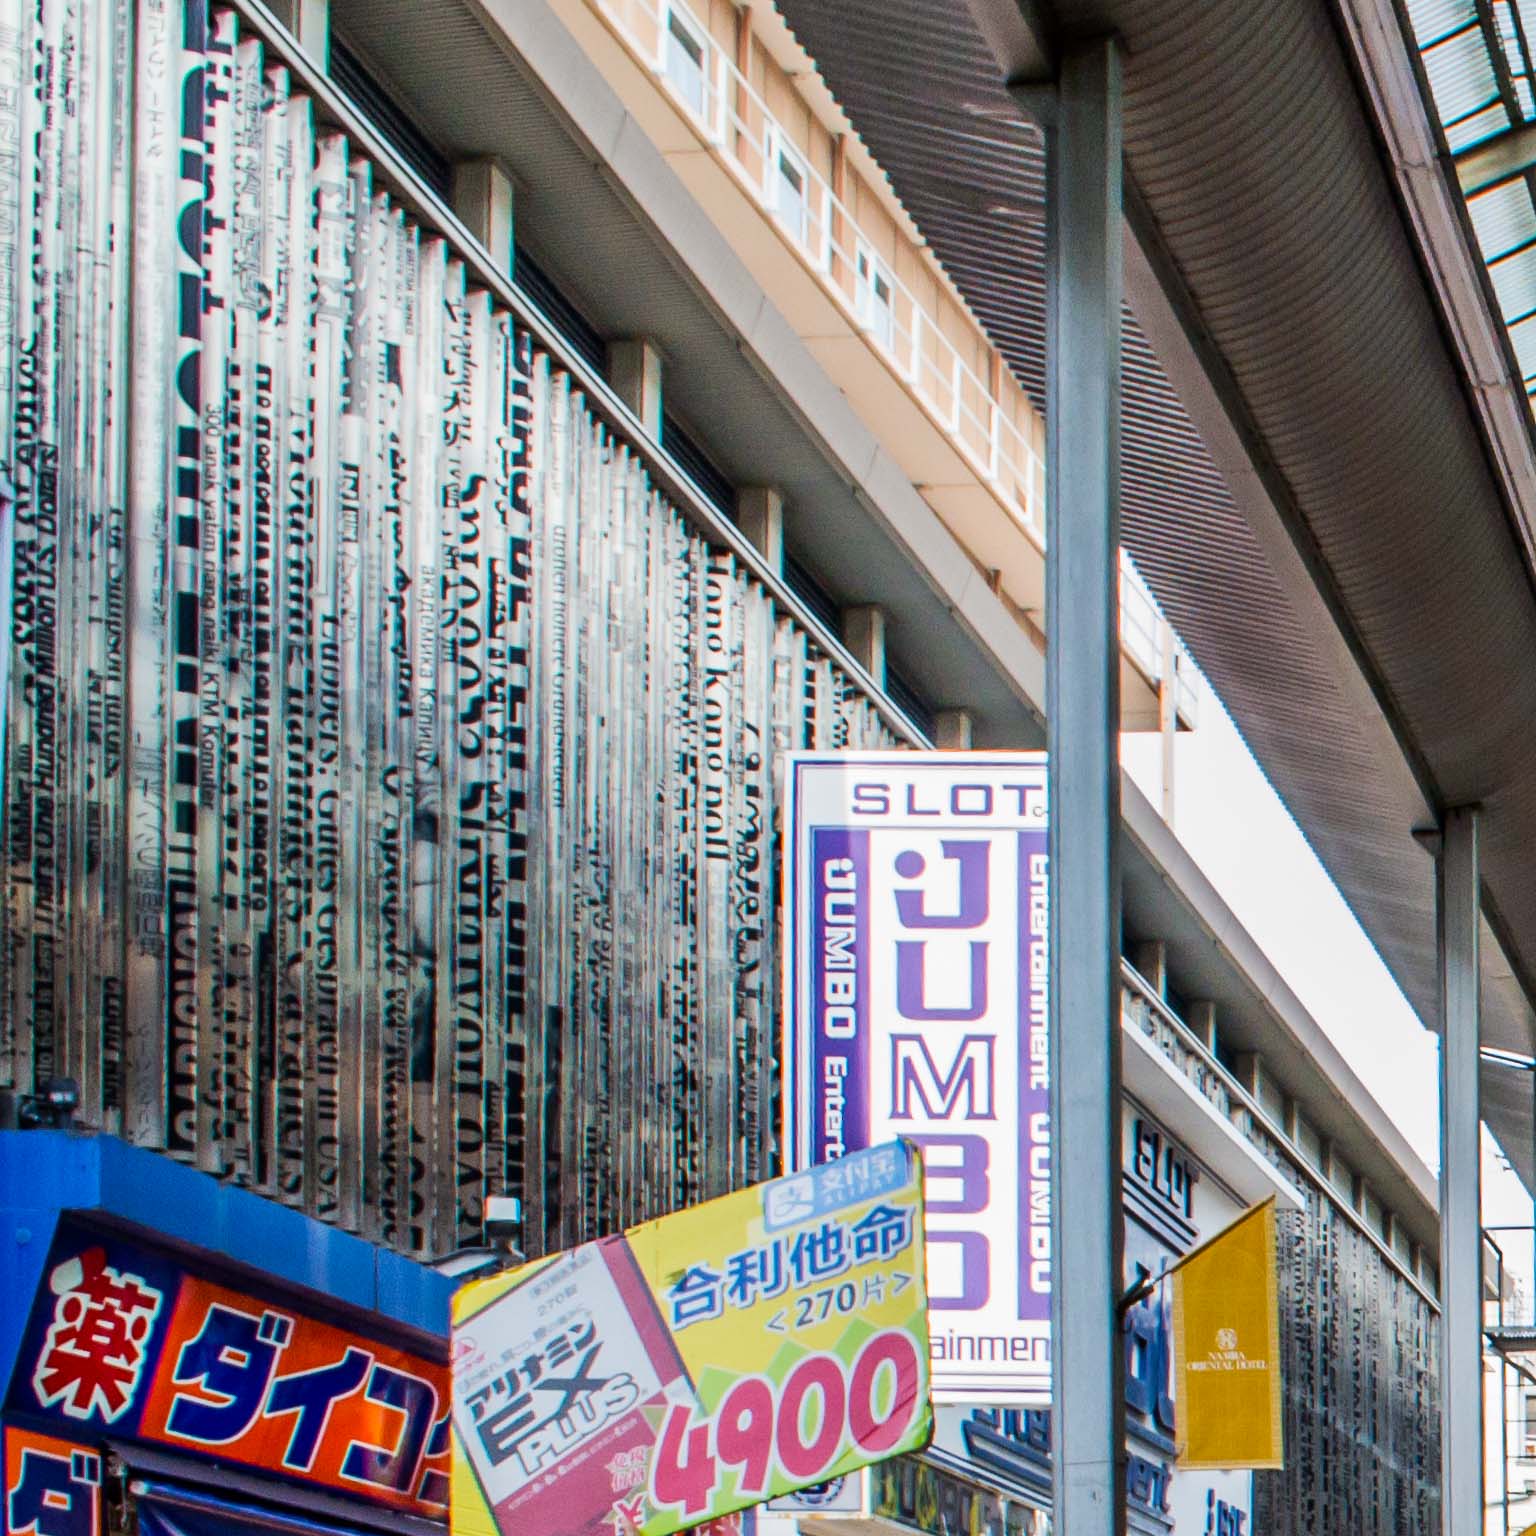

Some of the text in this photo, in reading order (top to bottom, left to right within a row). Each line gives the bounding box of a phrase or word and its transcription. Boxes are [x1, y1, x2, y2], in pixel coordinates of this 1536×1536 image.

[853, 782, 1043, 816] SLOT
[824, 858, 857, 1039] JUMBO
[889, 840, 999, 1310] JUMBO
[821, 1150, 897, 1191] 支付宝
[668, 1204, 915, 1331] 合利他命
[33, 1247, 162, 1424] 薬
[165, 1303, 450, 1500] ダイコ
[464, 1316, 599, 1425] アリナミン
[477, 1339, 606, 1468] EX
[512, 1370, 645, 1477] PLUS
[651, 1327, 922, 1520] 4900
